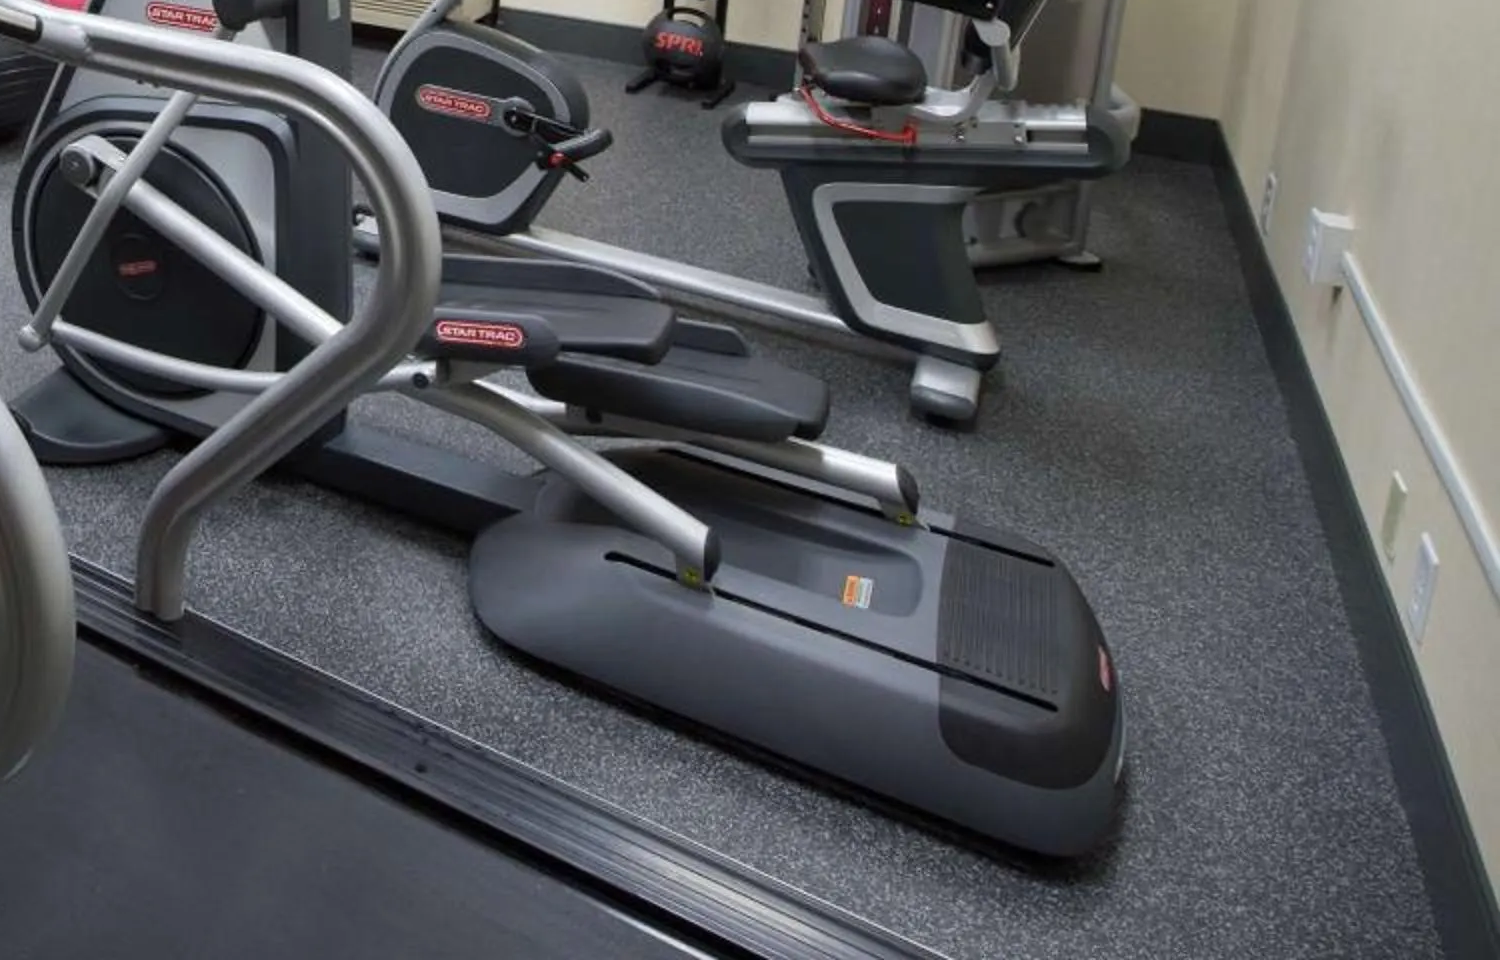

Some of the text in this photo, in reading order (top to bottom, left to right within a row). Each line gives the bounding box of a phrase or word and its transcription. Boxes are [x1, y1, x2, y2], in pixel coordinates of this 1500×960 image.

[151, 7, 184, 19] STAR
[425, 94, 485, 112] STAR TRAC
[443, 326, 516, 341] STAR TRAC
